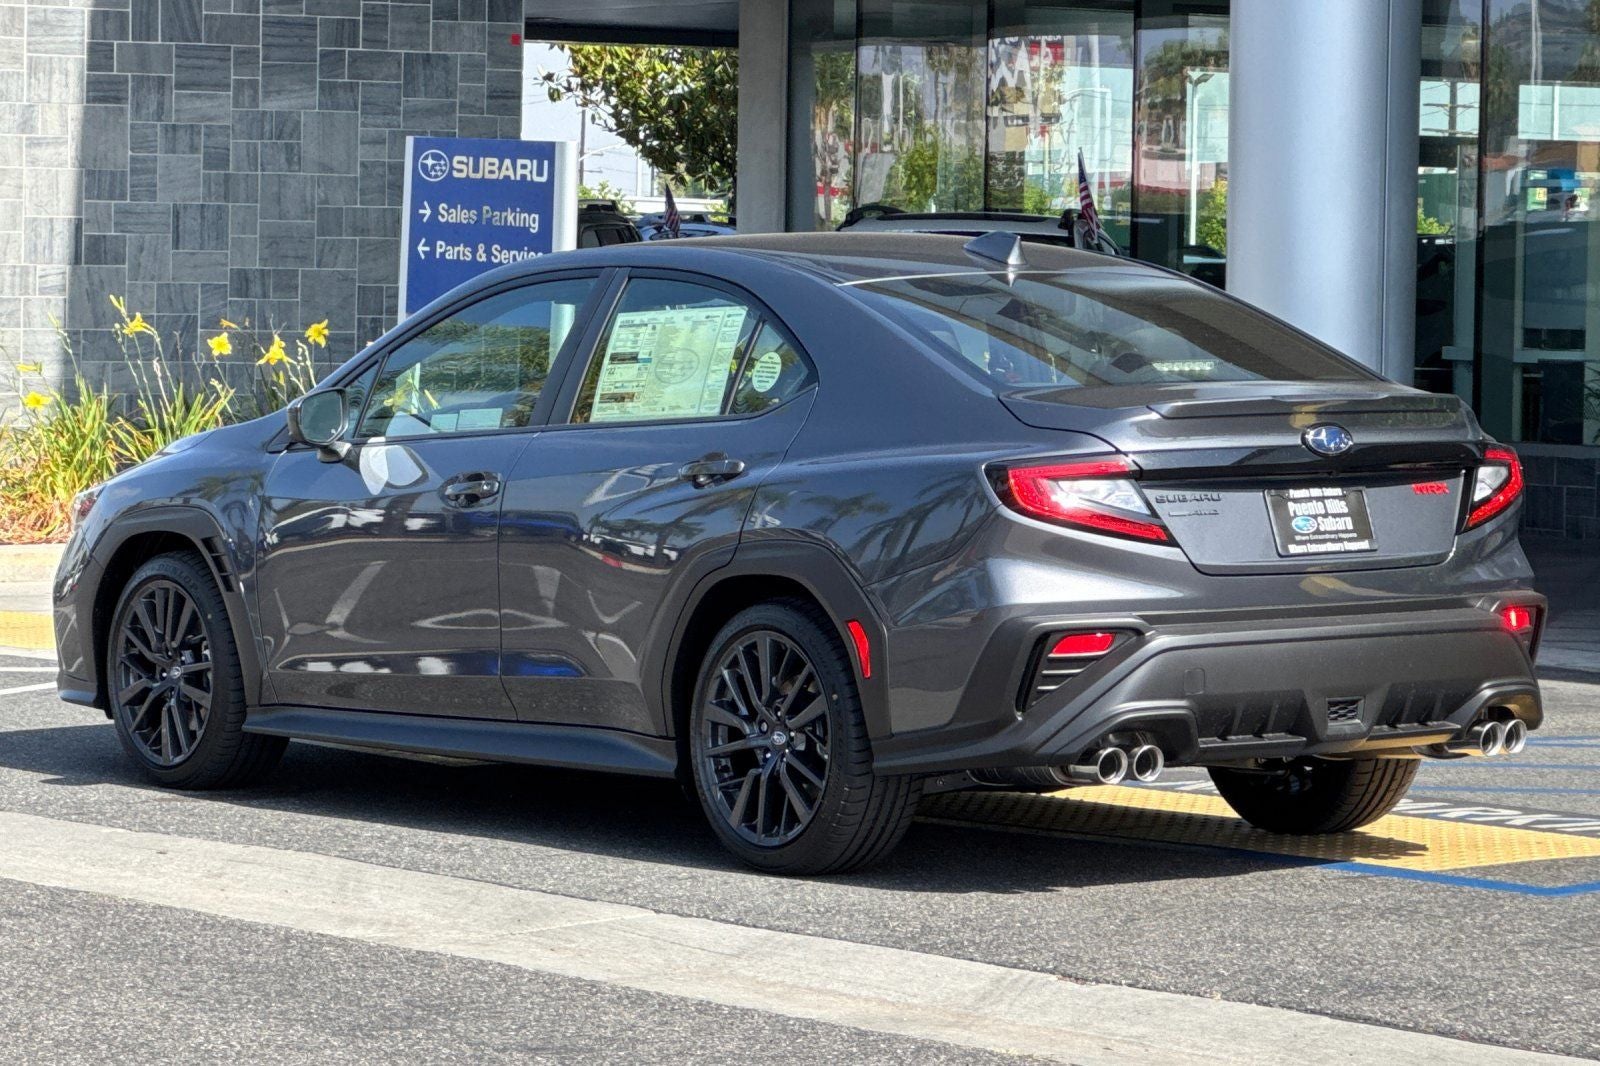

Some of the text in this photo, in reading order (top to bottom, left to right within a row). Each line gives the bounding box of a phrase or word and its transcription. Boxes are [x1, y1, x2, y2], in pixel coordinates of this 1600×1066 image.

[451, 155, 548, 183] SUBARU
[437, 202, 540, 234] Sales Parking
[435, 240, 472, 261] Parts
[476, 243, 487, 262] &
[1411, 482, 1450, 495] WRX
[1155, 493, 1222, 503] SUBARU
[1287, 499, 1348, 516] Puente Hills
[1317, 516, 1353, 531] Subaru
